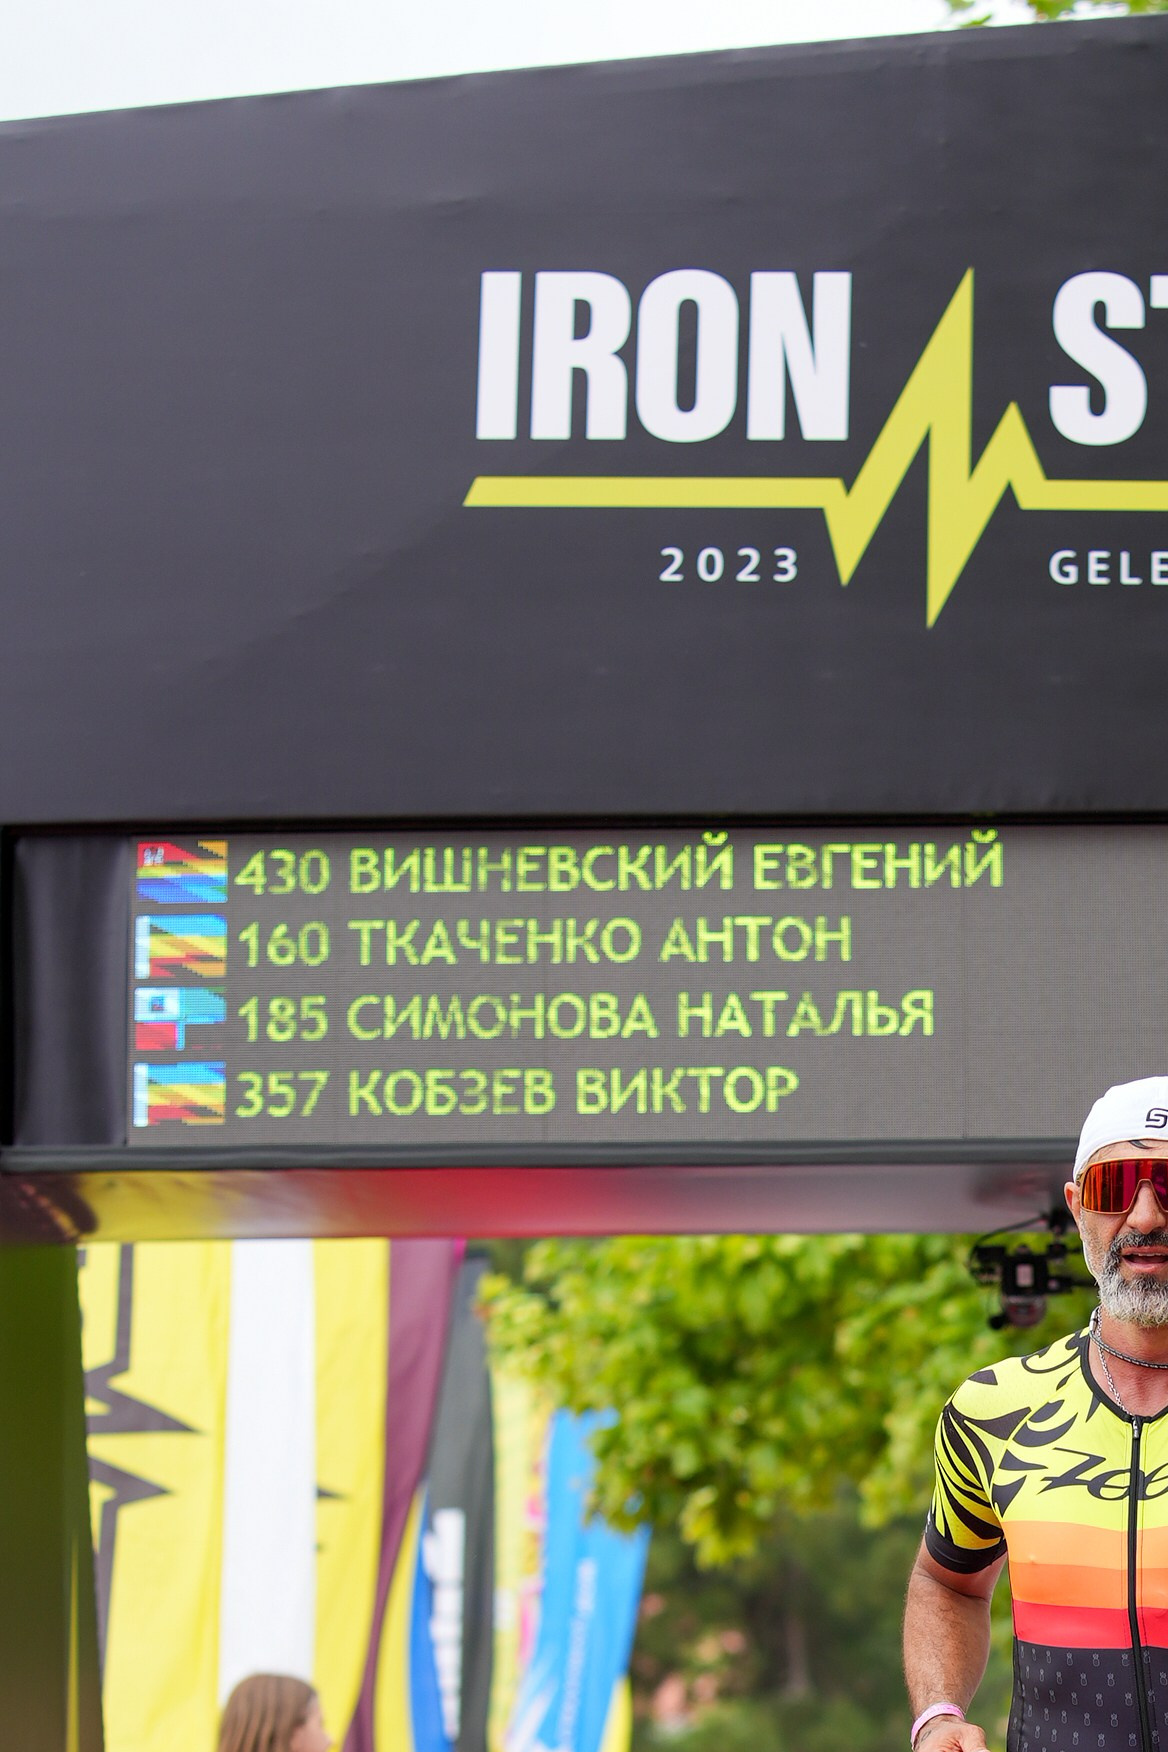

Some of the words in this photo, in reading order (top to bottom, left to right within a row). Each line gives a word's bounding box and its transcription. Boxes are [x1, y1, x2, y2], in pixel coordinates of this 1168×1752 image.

[476, 269, 852, 443] IRON
[658, 546, 798, 583] 2023
[235, 848, 332, 895] 430
[349, 830, 734, 893] ВИШНЕВСКИЙ
[752, 829, 1004, 890] ЕВГЕНИЙ
[237, 921, 330, 967] 160
[347, 916, 642, 966] ТКАЧЕНКО
[659, 915, 853, 963] АНТОН
[237, 994, 329, 1042] 185
[346, 991, 659, 1042] СИМОНОВА
[676, 988, 936, 1037] НАТАЛЬЯ
[235, 1070, 329, 1117] 357
[348, 1067, 557, 1116] КОБЗЕВ
[575, 1065, 800, 1115] ВИКТОР
